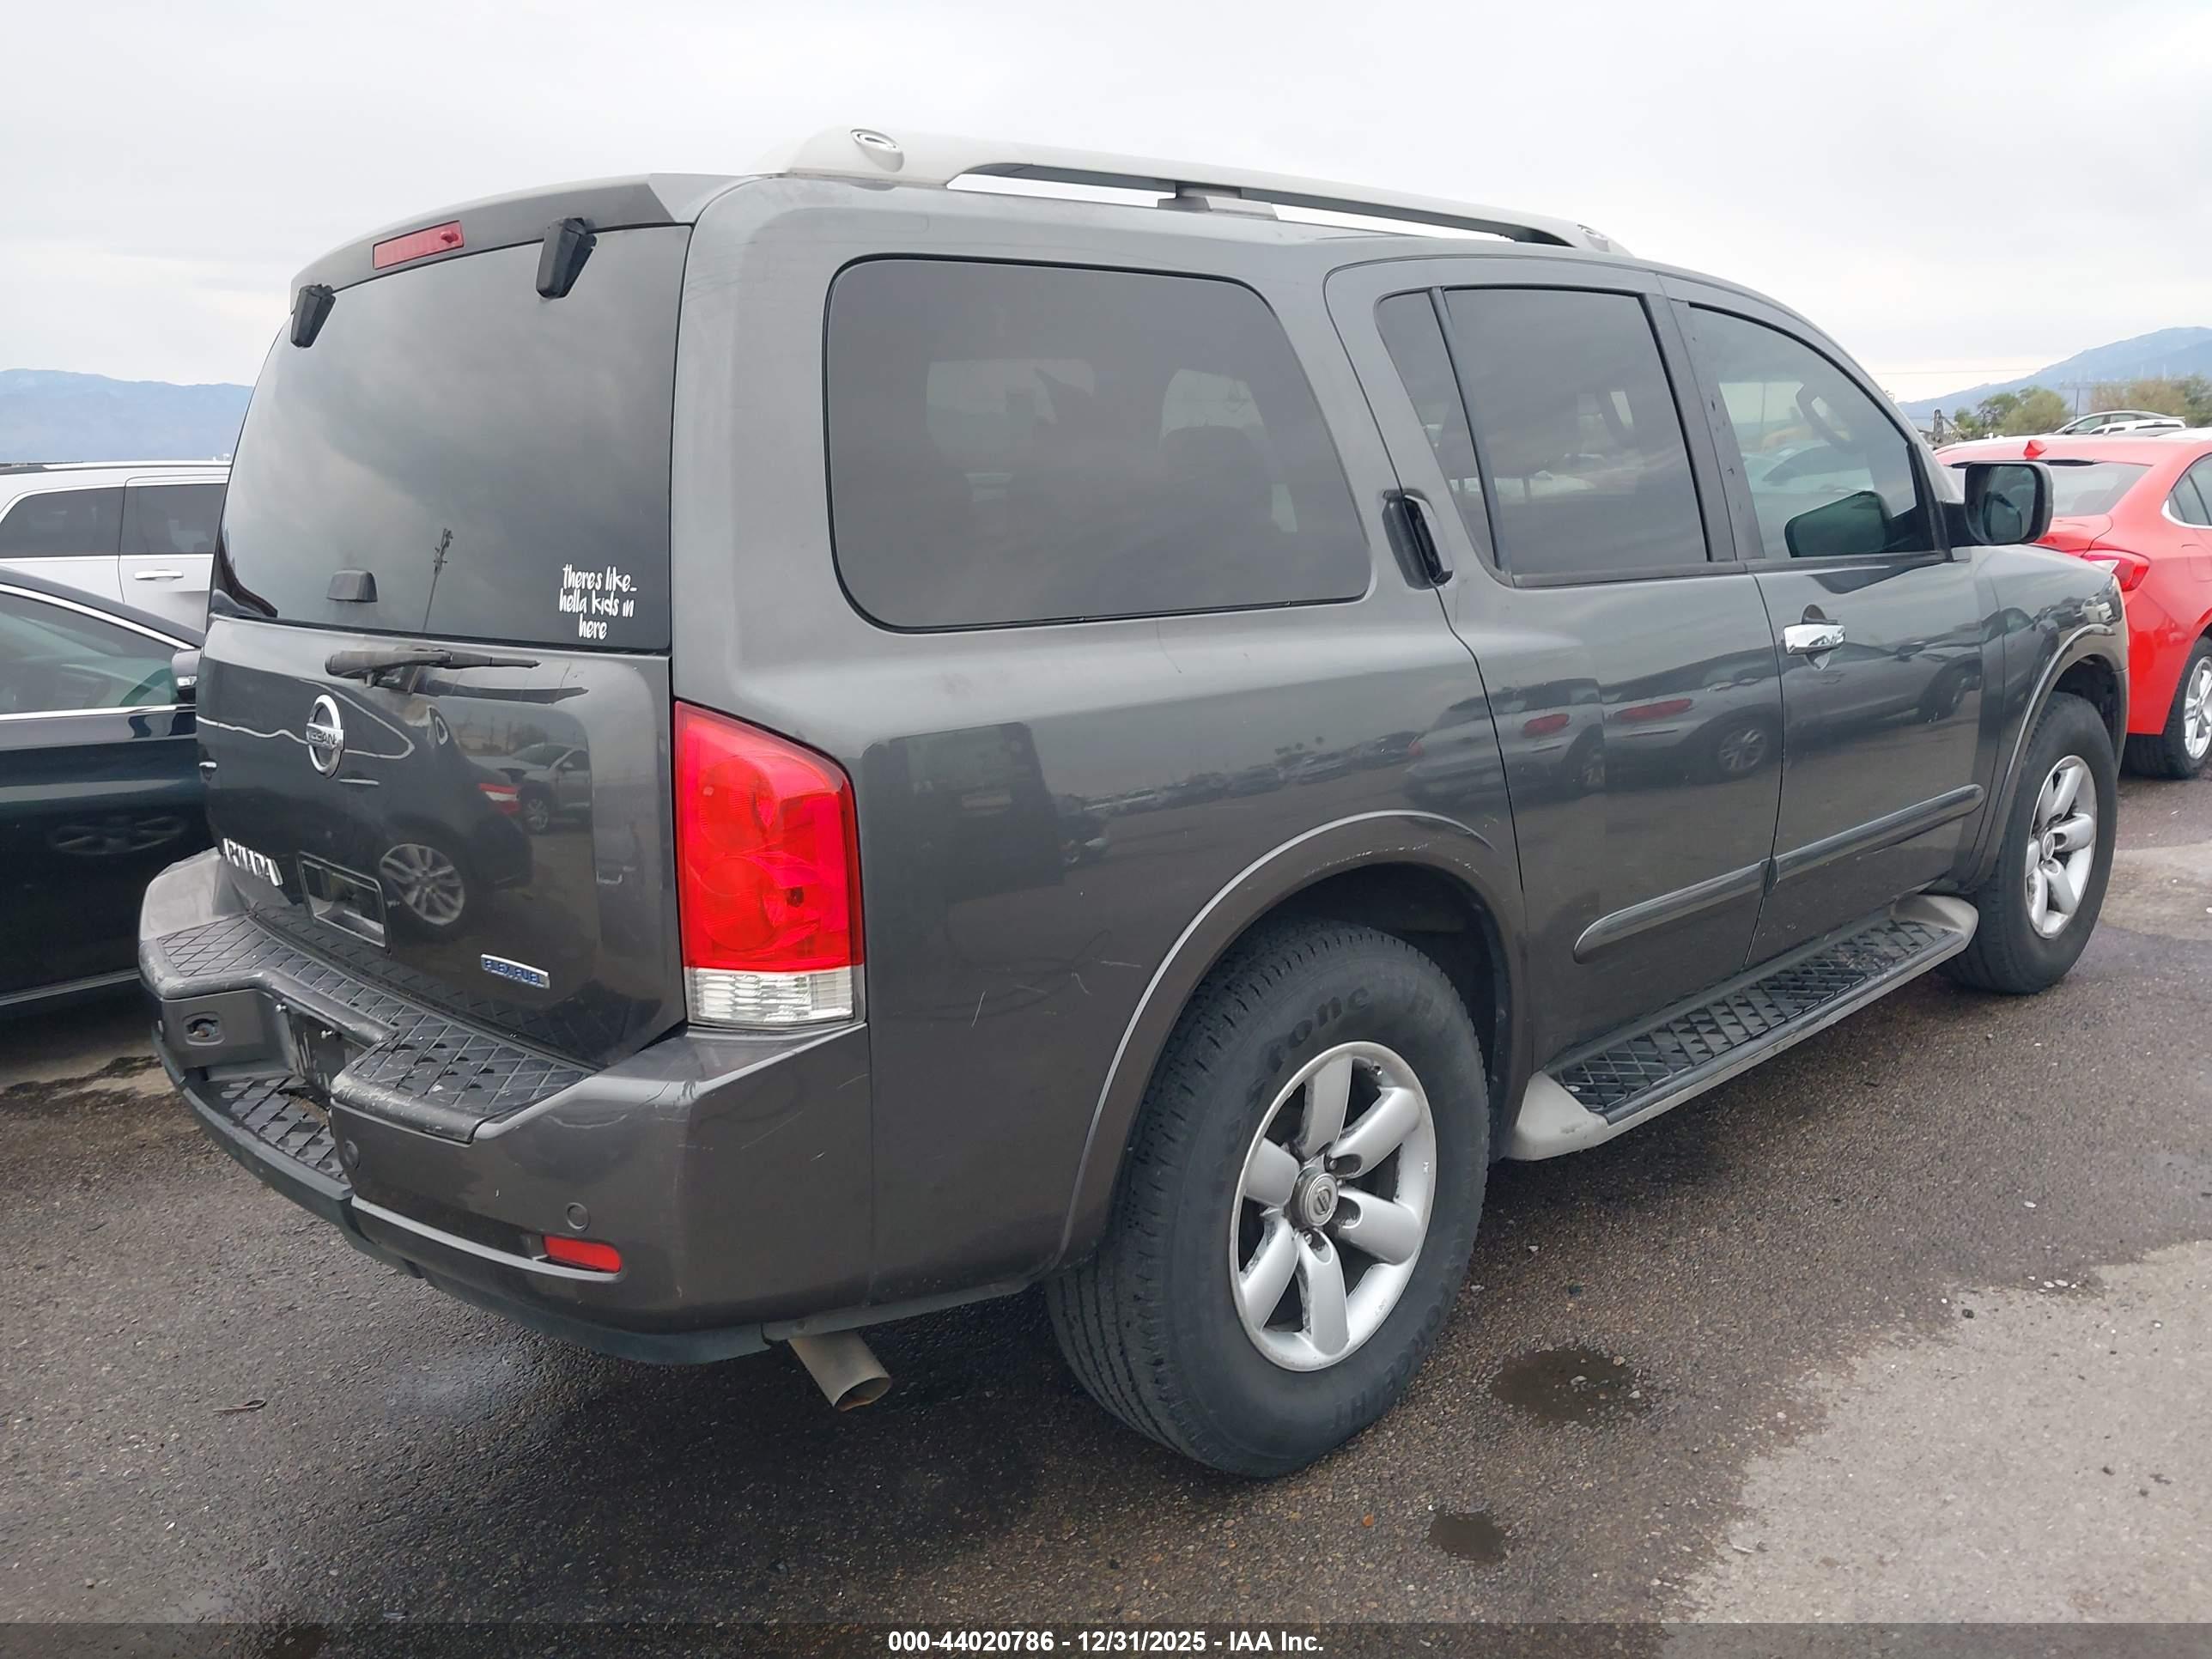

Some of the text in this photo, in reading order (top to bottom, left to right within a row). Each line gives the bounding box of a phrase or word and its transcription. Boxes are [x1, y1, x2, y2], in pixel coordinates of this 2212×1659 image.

[562, 563, 603, 591] theres
[559, 587, 635, 617] hella kids in
[578, 613, 608, 640] here
